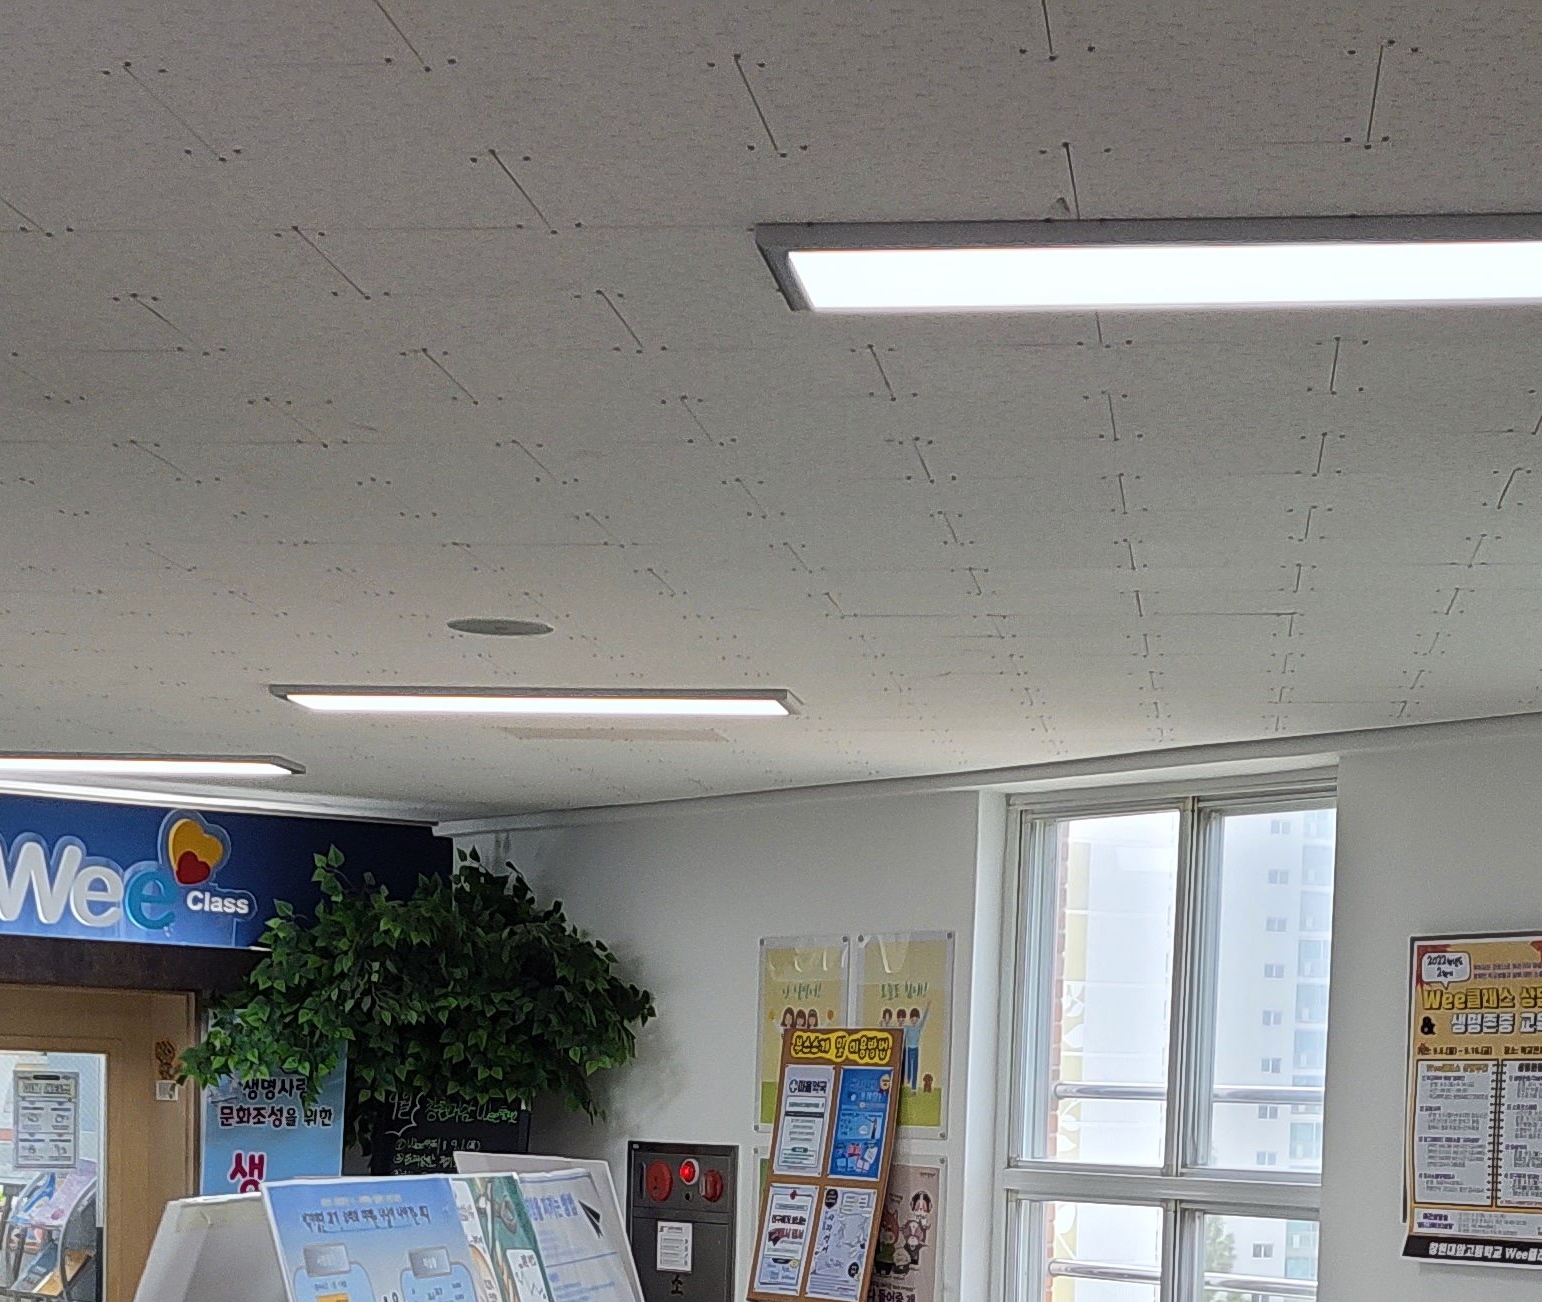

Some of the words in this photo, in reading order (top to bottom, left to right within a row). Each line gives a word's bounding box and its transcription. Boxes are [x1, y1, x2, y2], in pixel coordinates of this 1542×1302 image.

[186, 889, 250, 915] Class
[1422, 986, 1516, 1011] Wee클래스
[1420, 1015, 1437, 1036] &
[1450, 1011, 1516, 1035] 생명존중
[219, 1104, 298, 1129] 문화조성을
[303, 1106, 333, 1127] 위한
